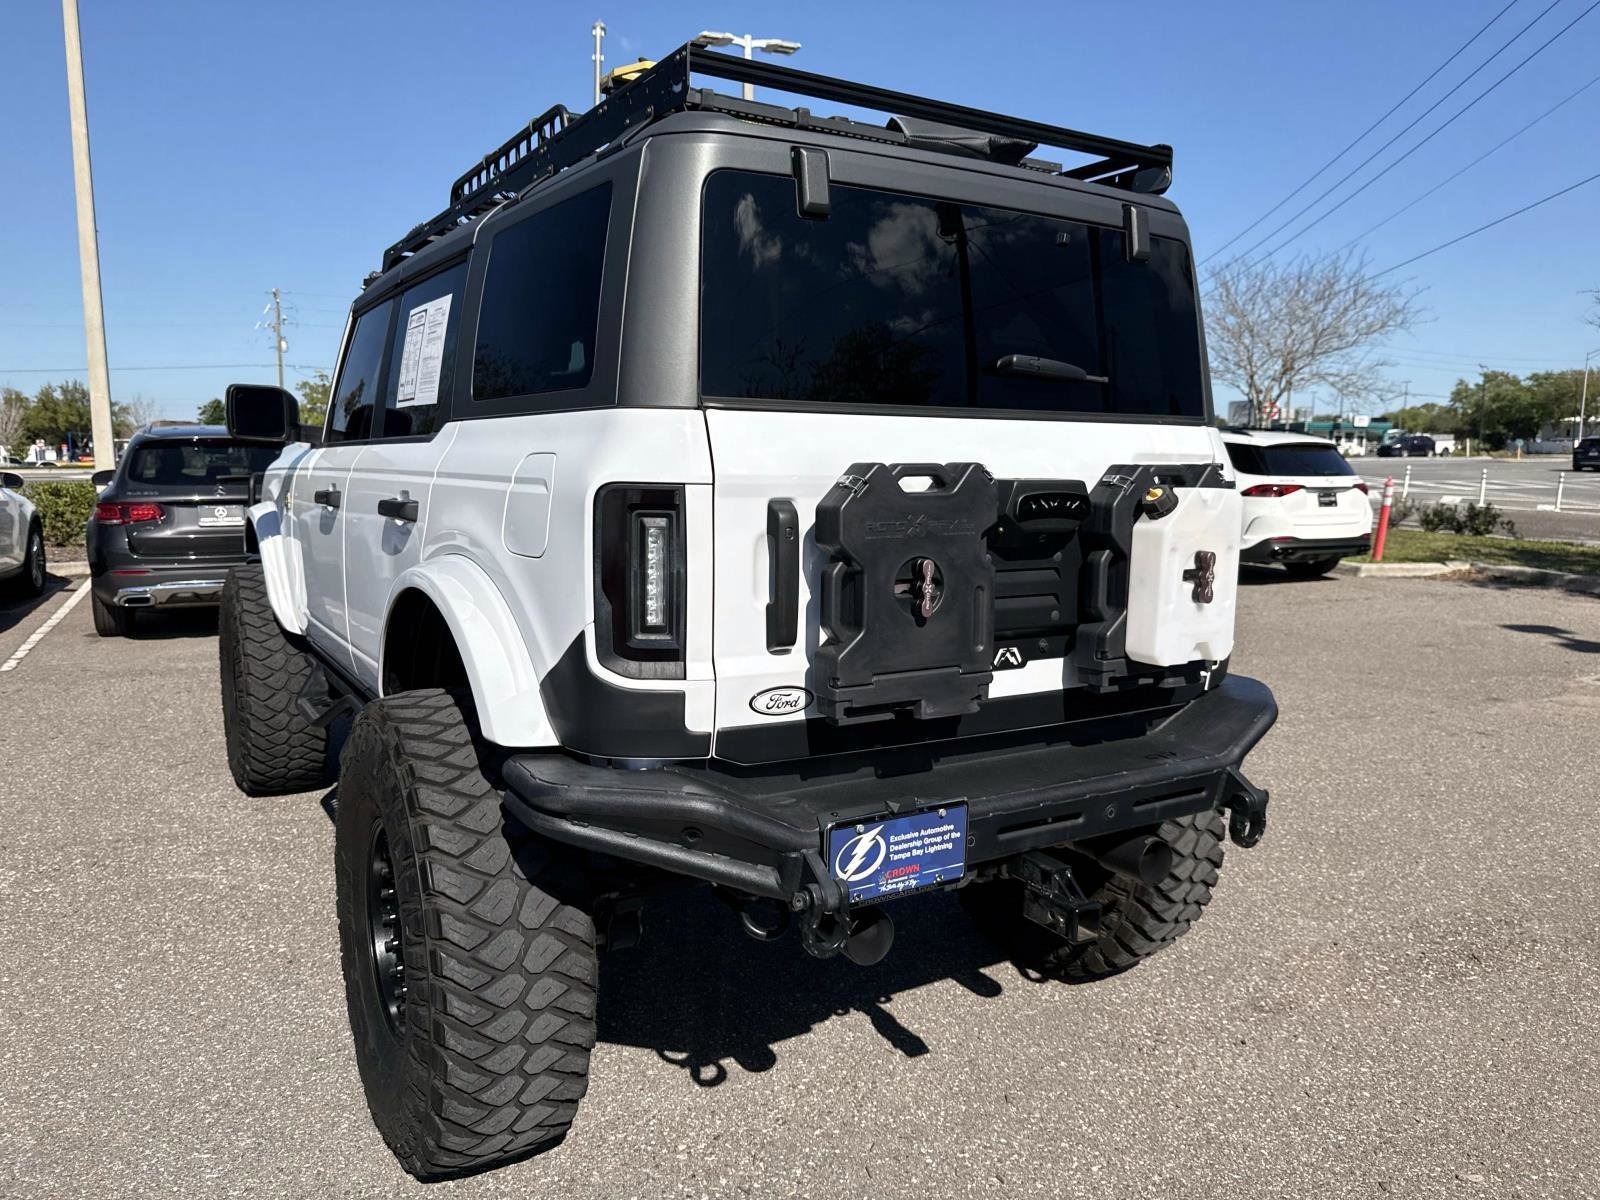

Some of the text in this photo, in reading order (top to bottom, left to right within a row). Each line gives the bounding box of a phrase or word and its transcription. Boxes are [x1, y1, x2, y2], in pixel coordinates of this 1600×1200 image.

[766, 693, 801, 710] Ford
[890, 825, 954, 842] Exclusive Automotive
[889, 839, 923, 852] Dealership
[923, 836, 943, 845] Group
[889, 842, 953, 861] Tampa Bay Lightning
[887, 864, 920, 878] CROWN
